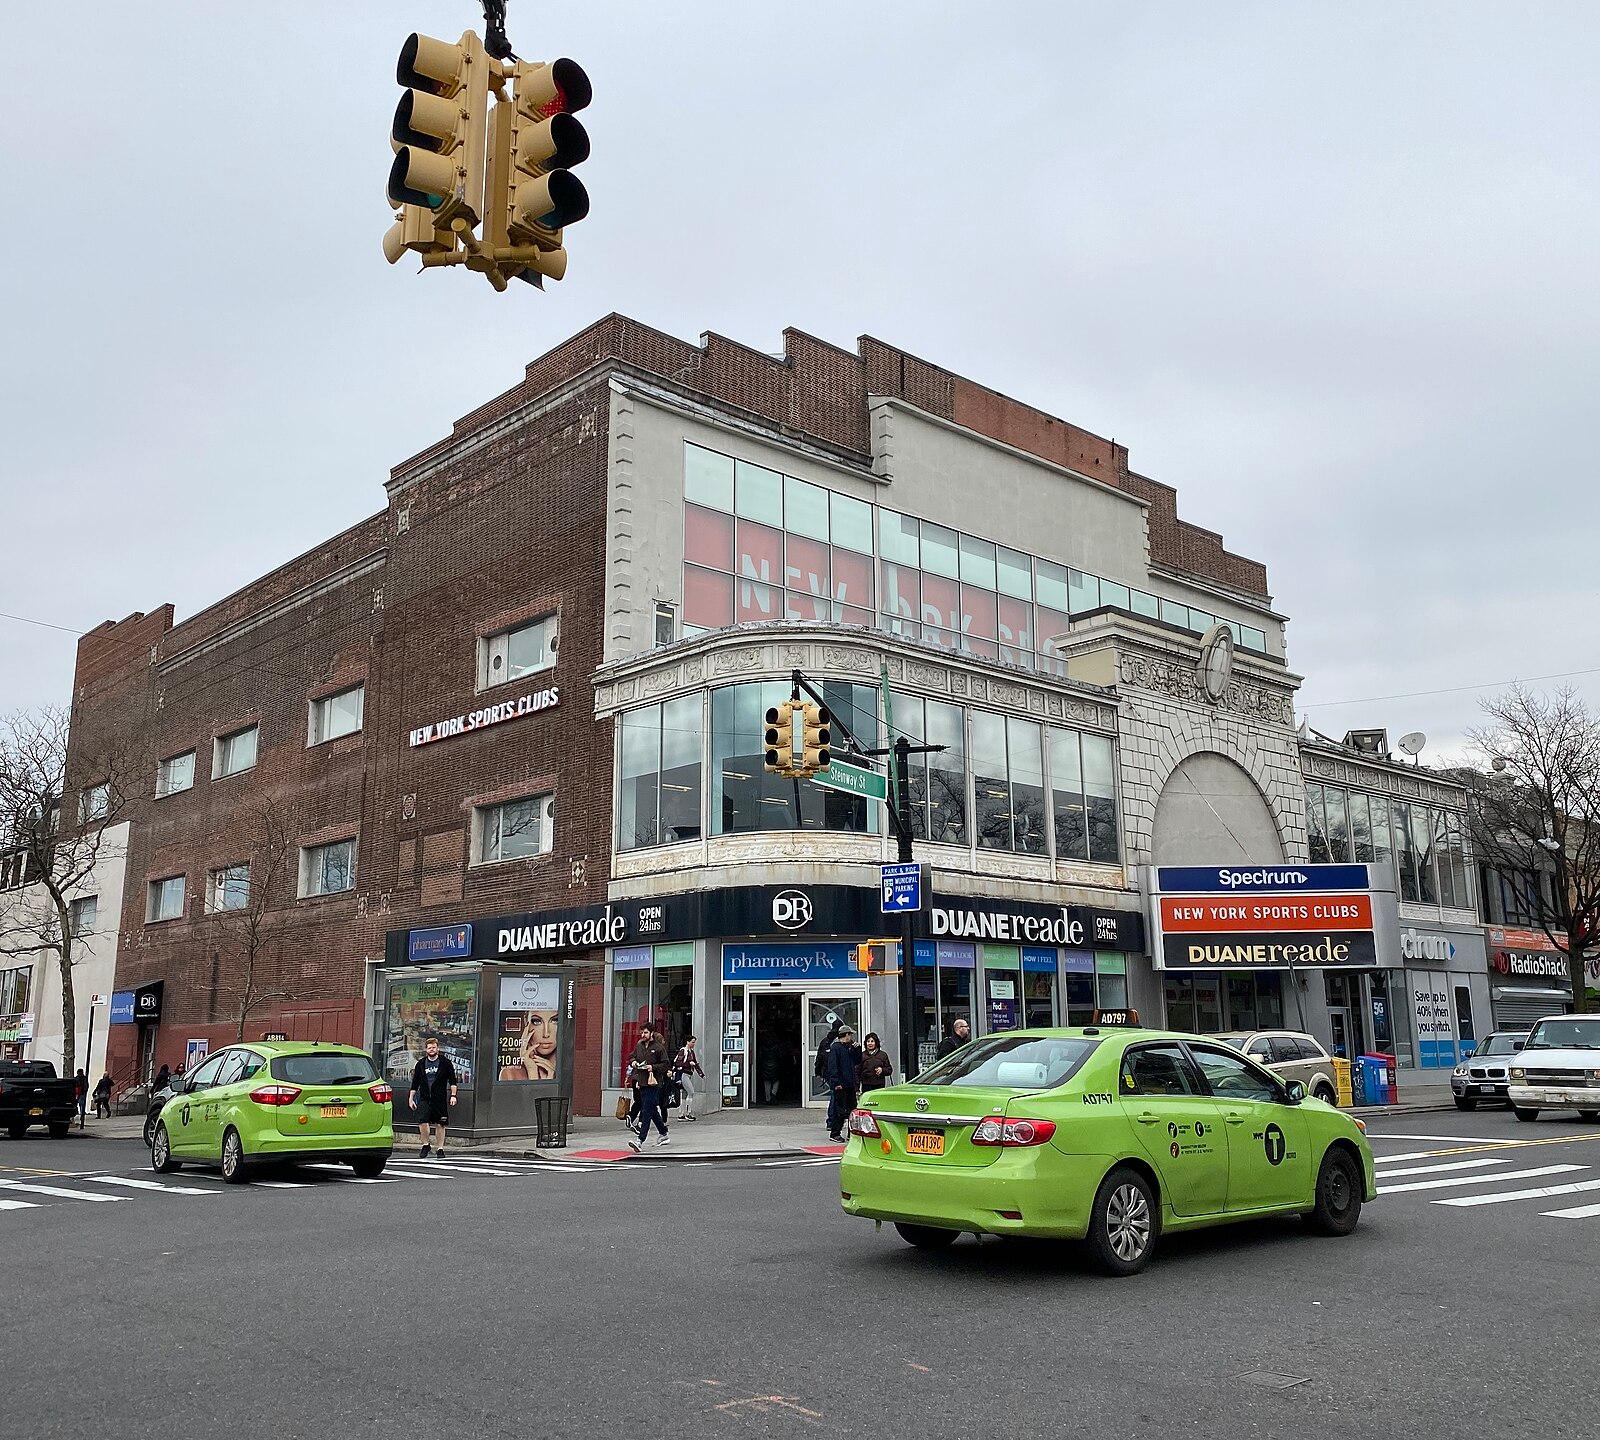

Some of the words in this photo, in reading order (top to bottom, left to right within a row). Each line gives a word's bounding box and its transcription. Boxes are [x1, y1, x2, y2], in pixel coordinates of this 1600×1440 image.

[742, 554, 847, 623] NEW
[410, 725, 433, 747] NEW
[436, 715, 466, 738] YORK
[468, 700, 515, 729] SPORTS
[518, 687, 559, 715] CLUBS
[831, 766, 857, 790] Steinway
[859, 775, 866, 790] St
[895, 876, 918, 884] MUNICIPAL
[1219, 869, 1302, 888] Spectrum
[884, 887, 893, 902] P
[895, 884, 914, 892] PARKING
[639, 906, 662, 920] OPEN
[1173, 907, 1204, 920] NEW
[1210, 906, 1247, 919] YORK
[1253, 905, 1308, 919] SPORTS
[1314, 905, 1359, 918] CLUBS
[639, 918, 662, 932] 24hrs
[1096, 917, 1116, 929] OPEN
[1097, 927, 1118, 941] 24hrs
[615, 954, 630, 963] HOW
[939, 950, 952, 958] HOW
[1509, 953, 1568, 976] RadioShack
[1415, 990, 1430, 1002] Save
[1440, 991, 1447, 1002] to
[992, 1001, 1008, 1010] FedEx
[1373, 1001, 1384, 1015] 5G
[1417, 1005, 1432, 1017] 40%
[1101, 1013, 1127, 1024] AD797
[1418, 1022, 1431, 1034] you
[1082, 1093, 1113, 1105] AD797
[910, 1134, 941, 1150] T684139C
[1252, 1132, 1264, 1140] NYC
[1268, 1131, 1280, 1160] T
